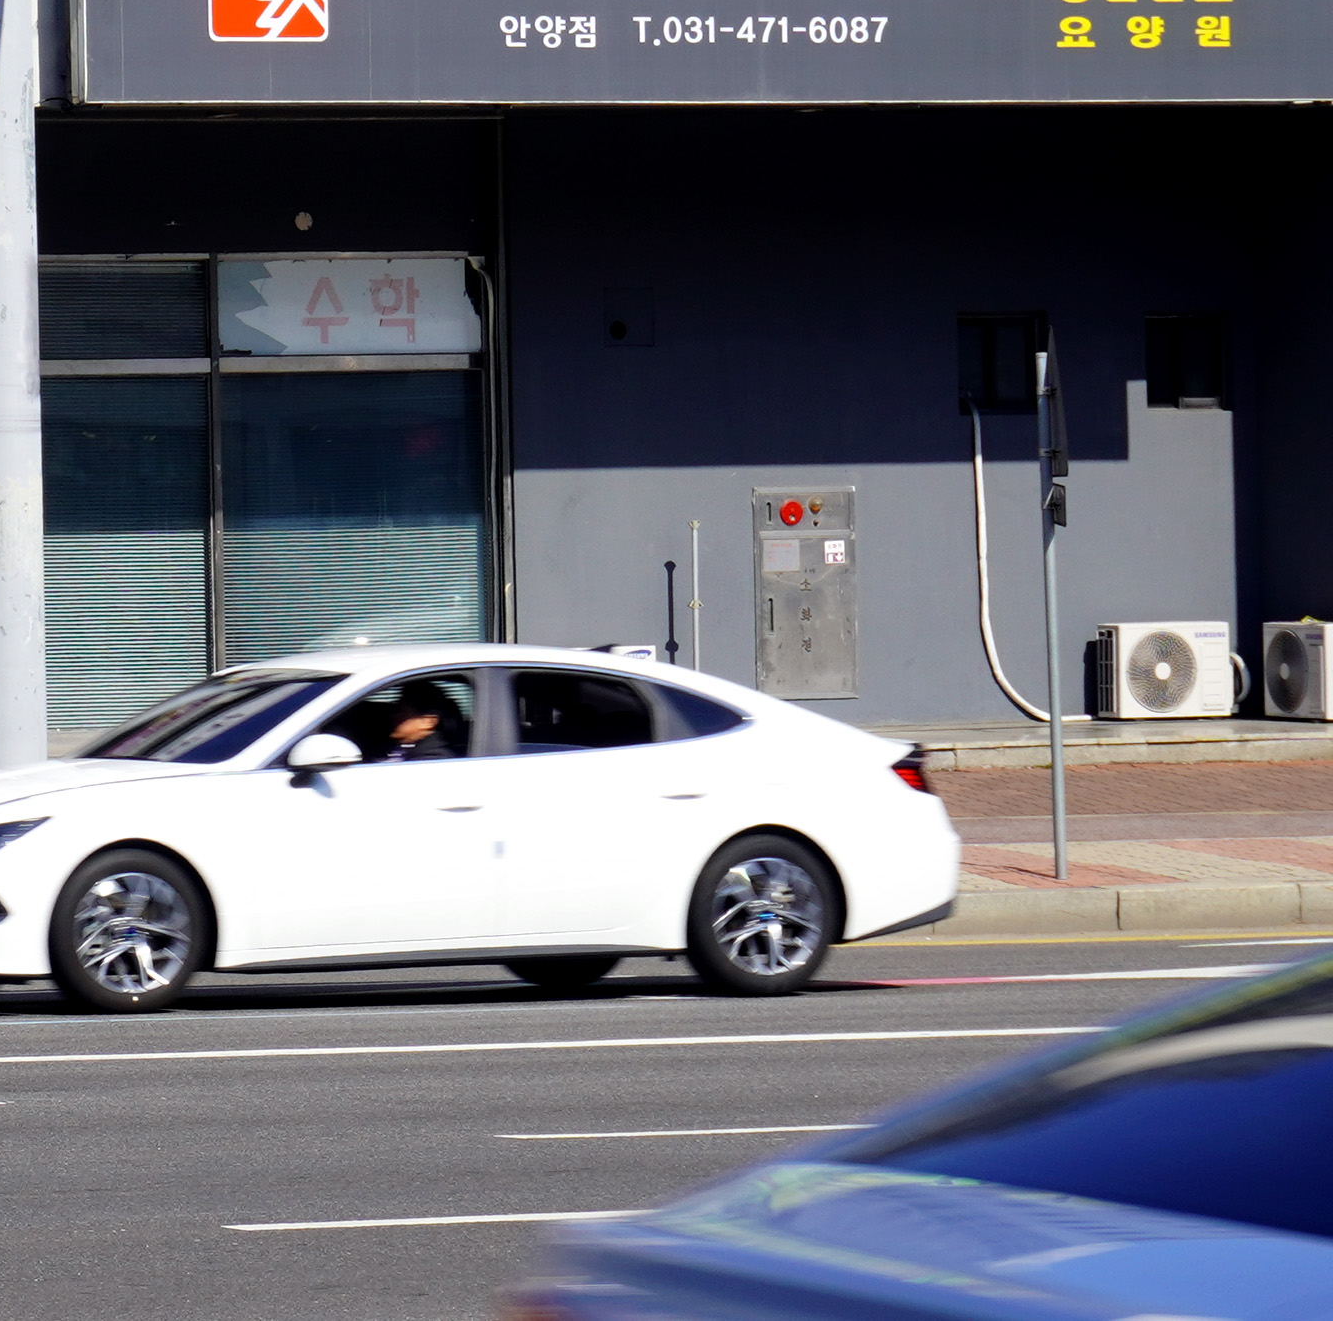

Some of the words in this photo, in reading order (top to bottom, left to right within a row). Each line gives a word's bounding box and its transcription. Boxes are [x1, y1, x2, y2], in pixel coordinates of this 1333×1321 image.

[499, 16, 597, 48] 안양점
[633, 16, 889, 47] T.031-471-6087
[1056, 16, 1232, 49] 요양원
[303, 273, 420, 344] 수학
